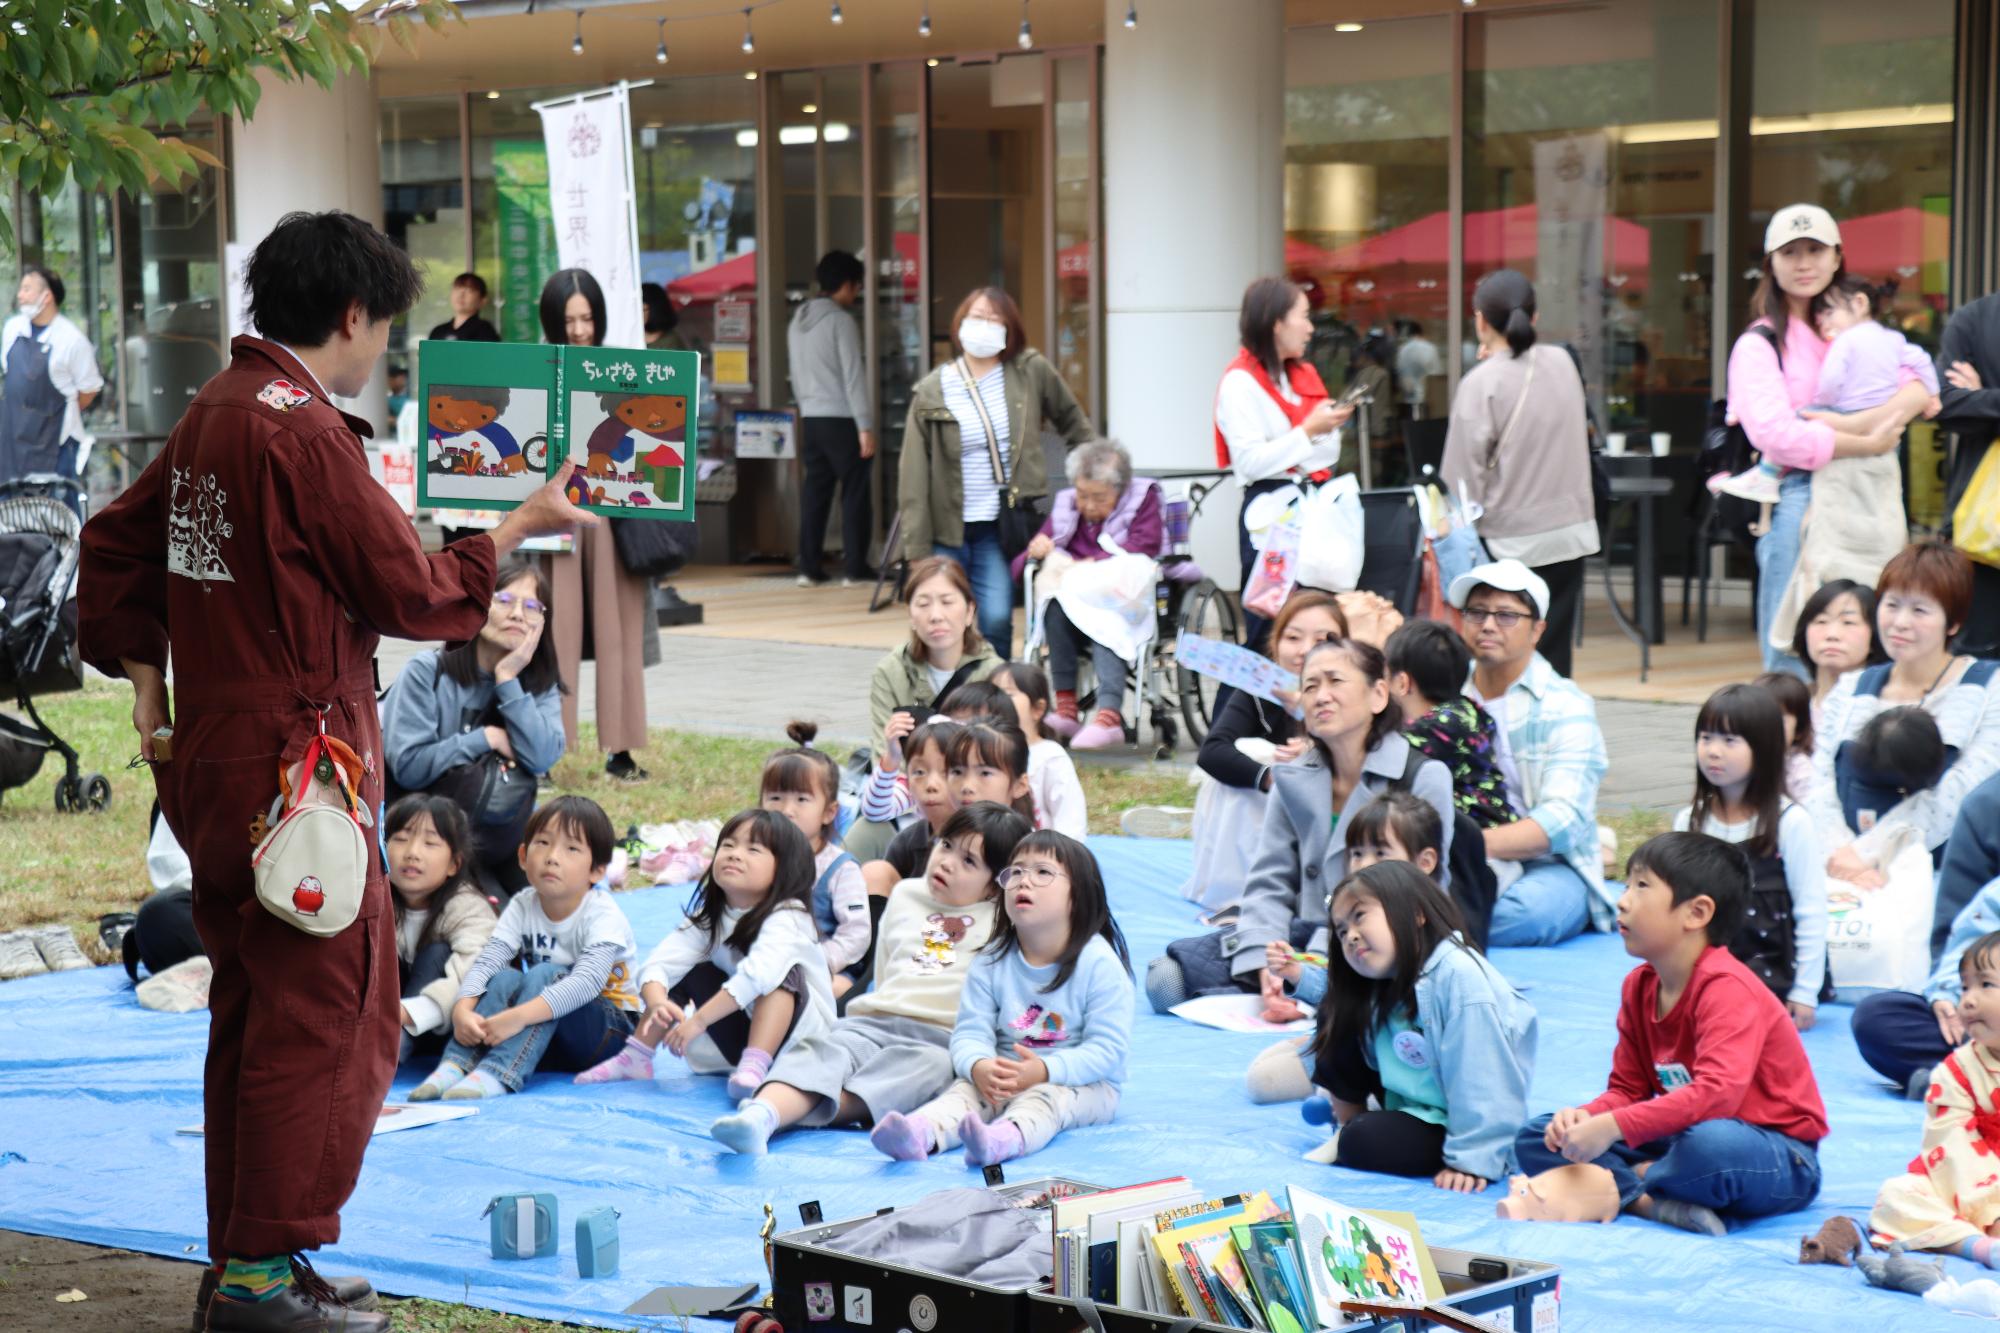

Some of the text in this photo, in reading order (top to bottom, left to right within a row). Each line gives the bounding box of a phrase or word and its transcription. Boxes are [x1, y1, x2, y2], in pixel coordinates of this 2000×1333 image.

[582, 360, 676, 384] ちいさな きしゃ
